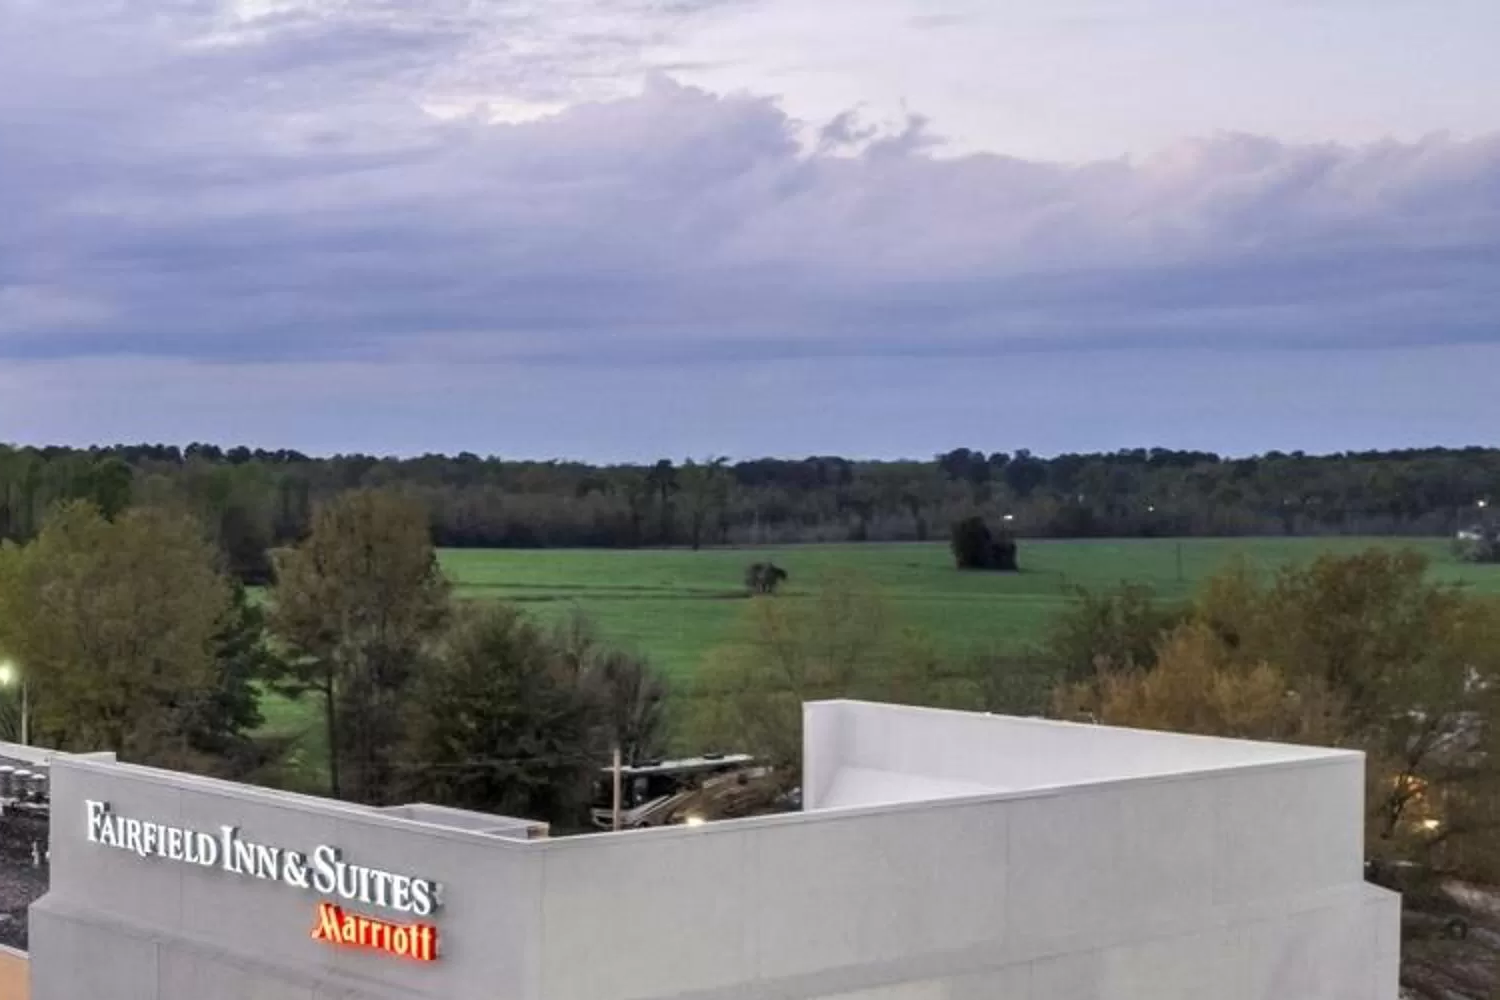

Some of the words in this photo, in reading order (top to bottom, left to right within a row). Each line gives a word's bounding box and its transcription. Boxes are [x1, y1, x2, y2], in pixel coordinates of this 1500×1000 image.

[85, 799, 215, 866] FAIRFIELD
[220, 825, 278, 881] INN
[283, 850, 310, 888] &
[314, 845, 431, 915] SUITES
[311, 902, 436, 961] Marriott
